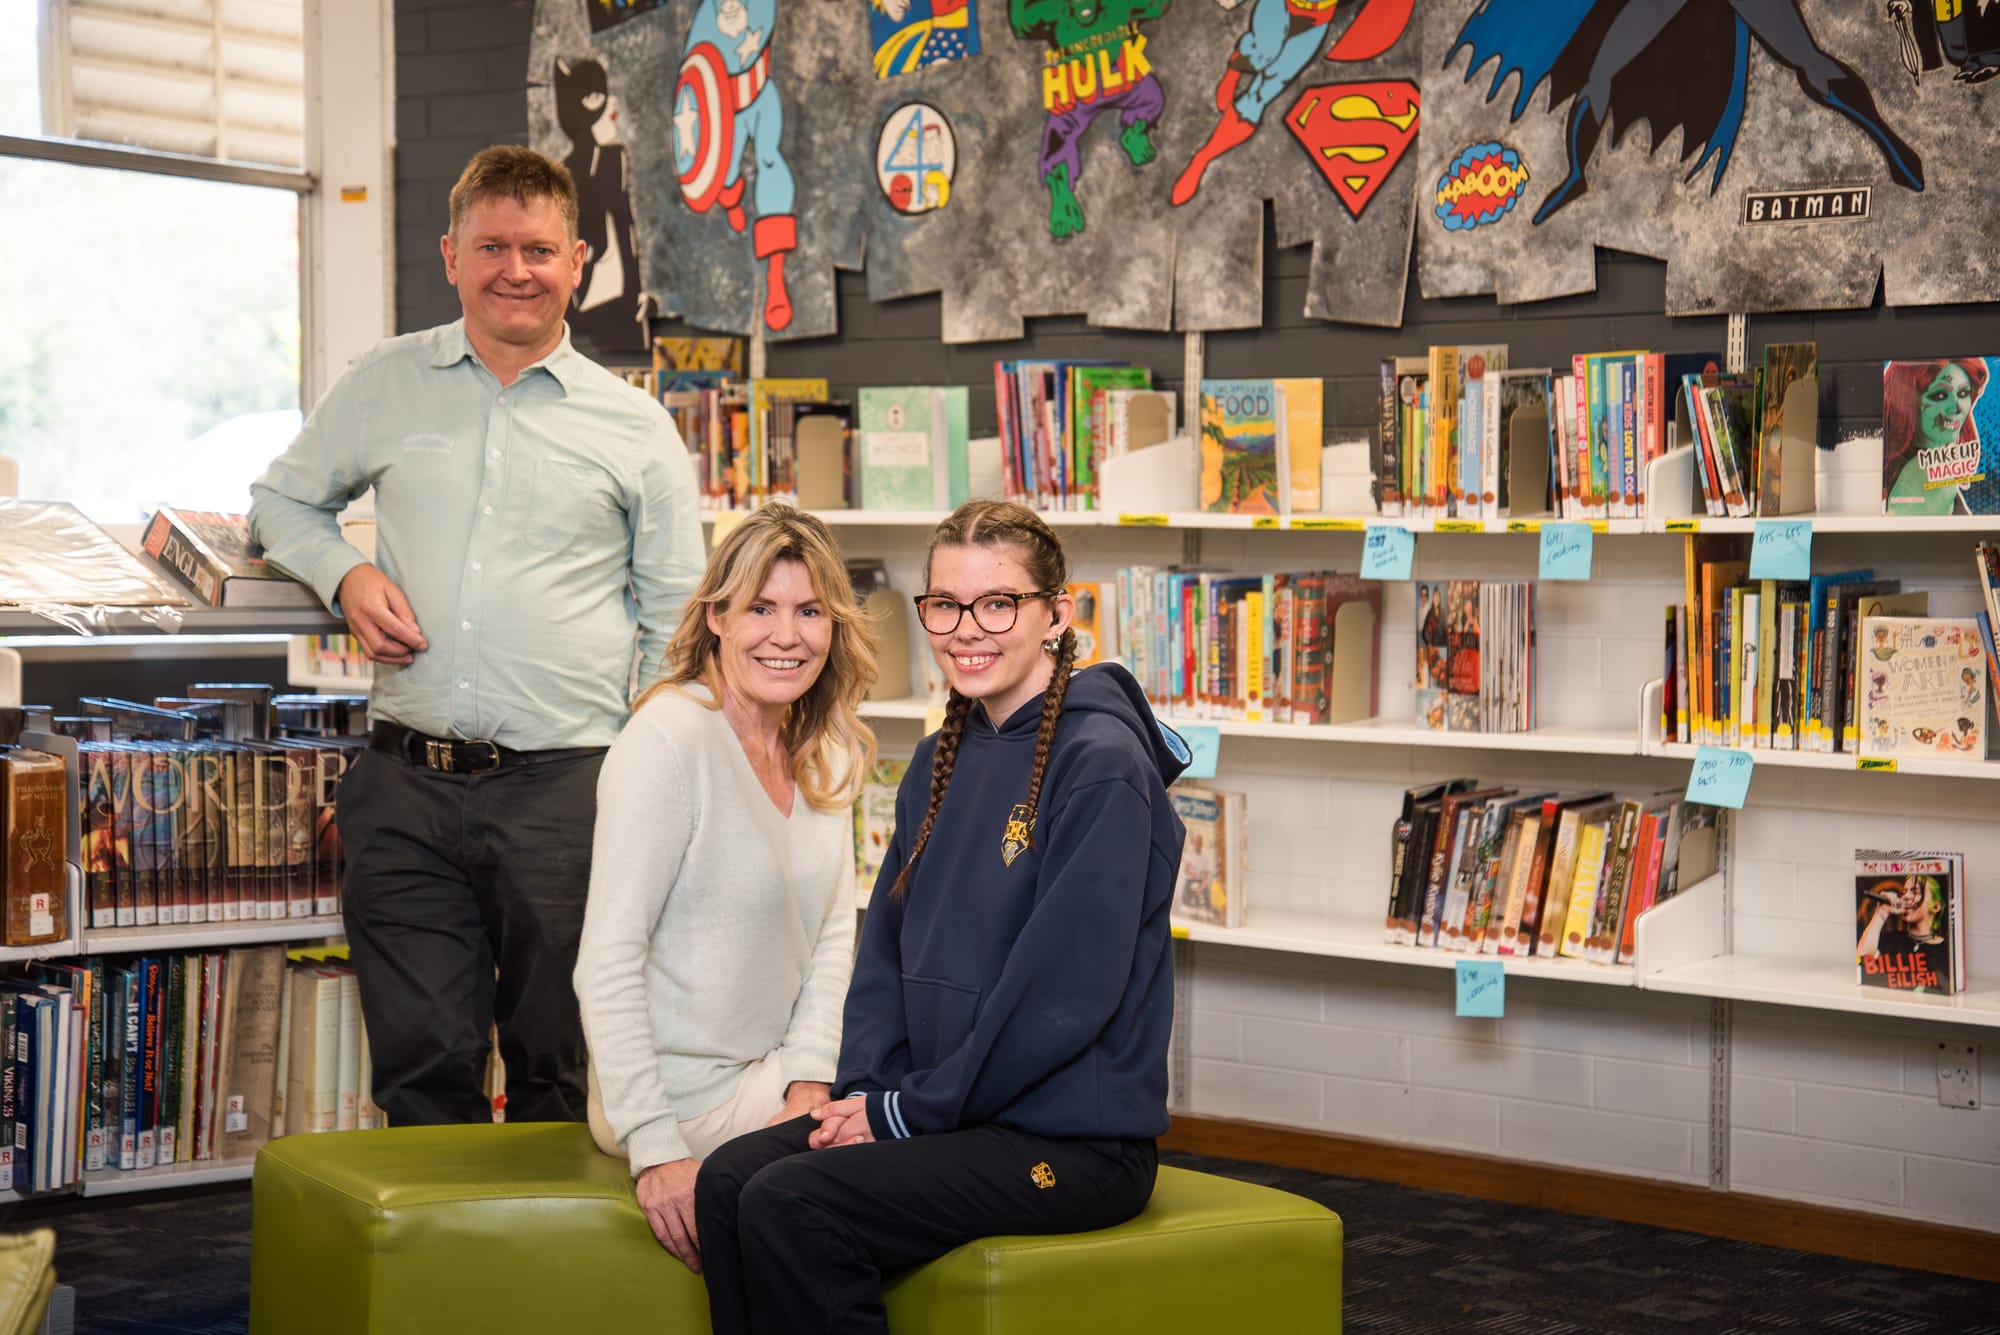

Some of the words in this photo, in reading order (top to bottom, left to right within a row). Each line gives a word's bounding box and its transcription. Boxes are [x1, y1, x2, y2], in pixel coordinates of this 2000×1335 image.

[1042, 33, 1152, 111] HULK
[884, 107, 944, 205] 4
[1437, 162, 1530, 207] KABOOM
[1751, 191, 1864, 221] BATMAN
[1214, 394, 1270, 416] FOOD
[1382, 396, 1395, 443] WINE
[1624, 430, 1634, 459] LOVE
[1624, 459, 1634, 476] TO
[1929, 459, 1975, 481] MAGIC
[1887, 654, 1947, 674] WOMEN
[1901, 670, 1945, 693] ART
[1430, 851, 1445, 883] Kylie
[1422, 884, 1440, 925] Kwong
[1862, 952, 1928, 975] BILLIE
[1887, 971, 1938, 989] EILISH
[126, 1013, 140, 1054] CAN'T
[145, 1013, 156, 1048] Believe
